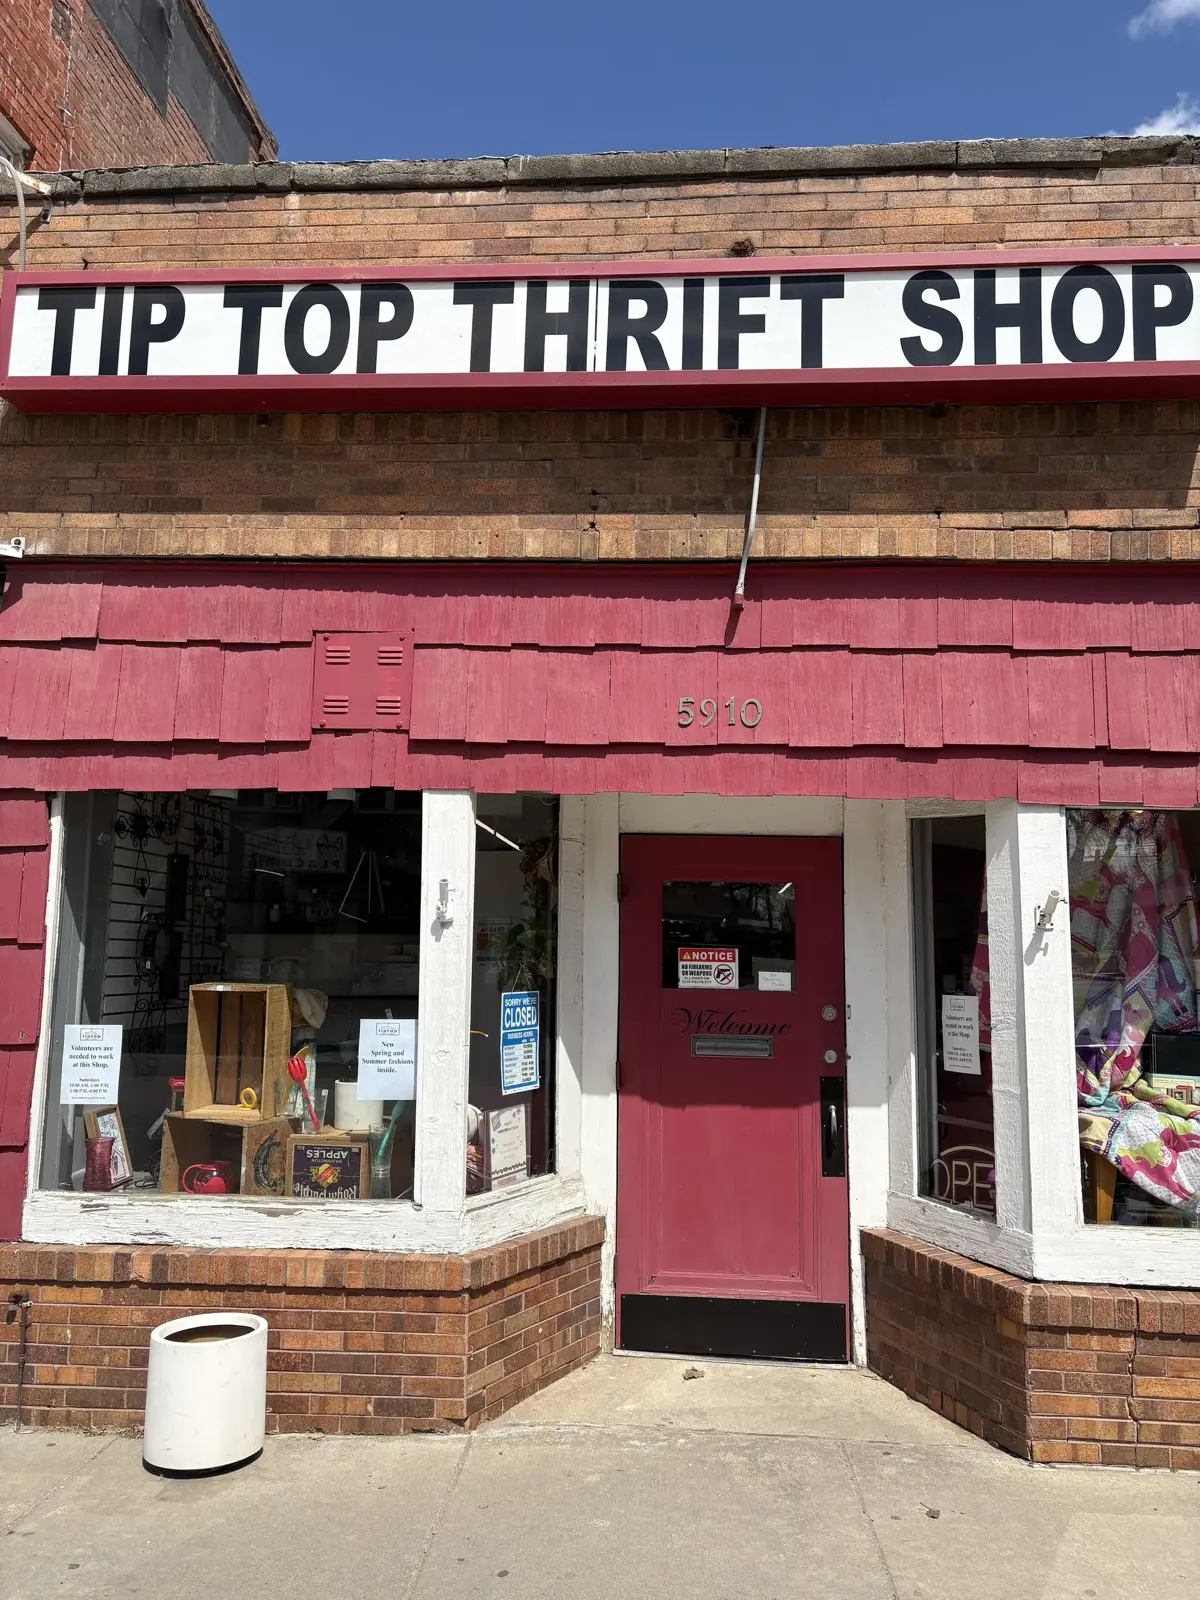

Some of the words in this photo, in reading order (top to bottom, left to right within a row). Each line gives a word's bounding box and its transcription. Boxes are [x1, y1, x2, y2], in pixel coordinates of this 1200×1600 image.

[38, 285, 185, 375] TIP
[223, 283, 414, 374] TOP
[453, 274, 845, 372] THRIFT
[900, 265, 1194, 366] SHOP
[678, 697, 762, 727] 5910
[692, 952, 733, 960] NOTICE
[504, 998, 522, 1007] SORRY
[522, 997, 537, 1005] WE'RE
[504, 1006, 537, 1028] CLOSED
[671, 1007, 792, 1036] Welcome
[306, 1150, 348, 1158] APPLES
[930, 1158, 994, 1210] OPE
